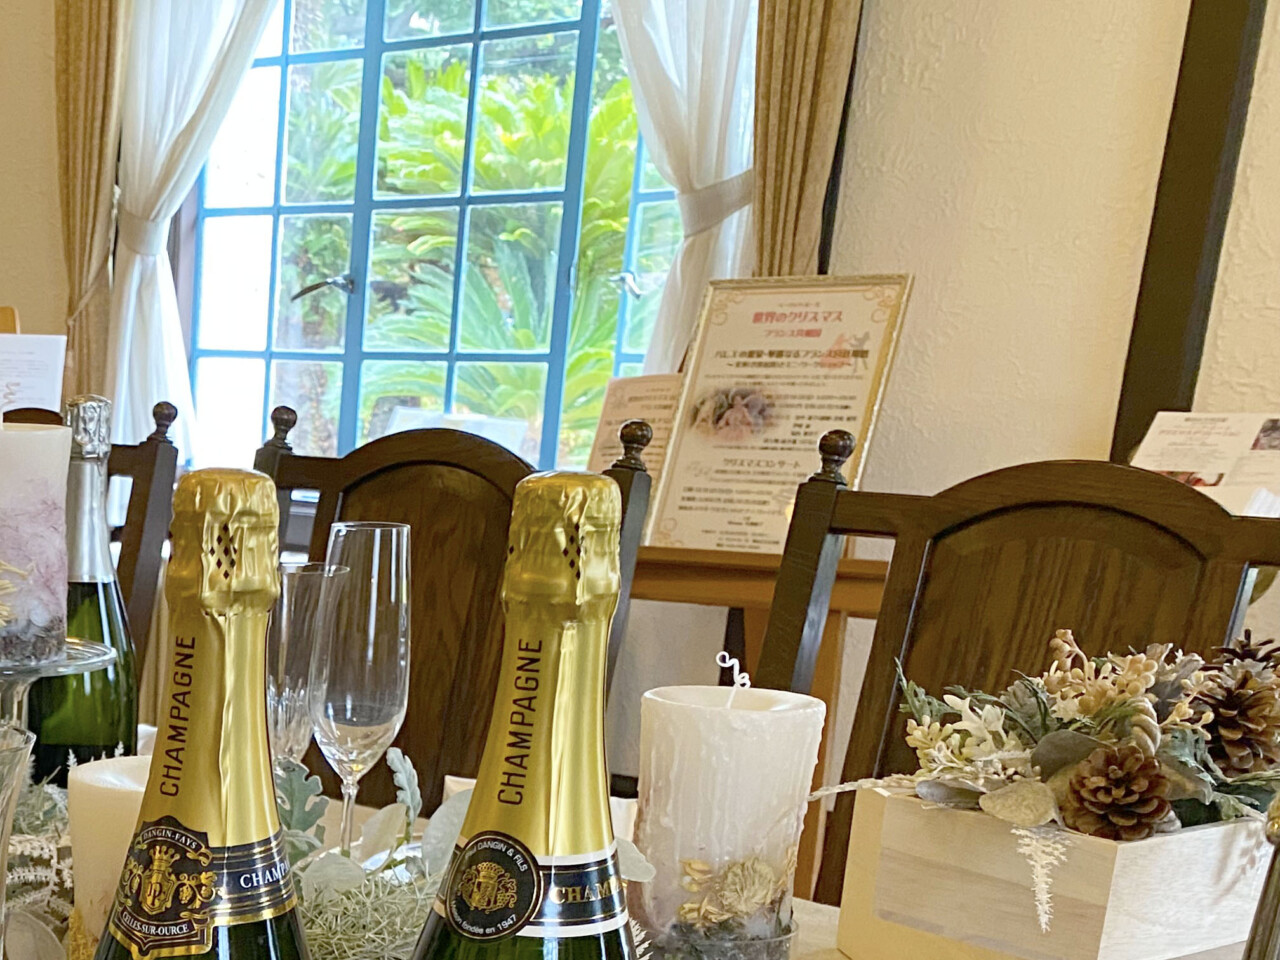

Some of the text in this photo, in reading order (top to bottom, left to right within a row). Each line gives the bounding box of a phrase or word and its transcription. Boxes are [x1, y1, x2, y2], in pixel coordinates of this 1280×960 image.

[160, 635, 196, 797] CHAMPAGNE
[497, 638, 543, 806] CHAMPAGNE
[143, 828, 197, 849] DANGIN-FAYS
[477, 841, 507, 852] DANGIN
[507, 848, 515, 857] &
[513, 854, 528, 872] FILS
[122, 912, 189, 935] CELLES-SUR-OURCE
[497, 914, 517, 931] 1947
